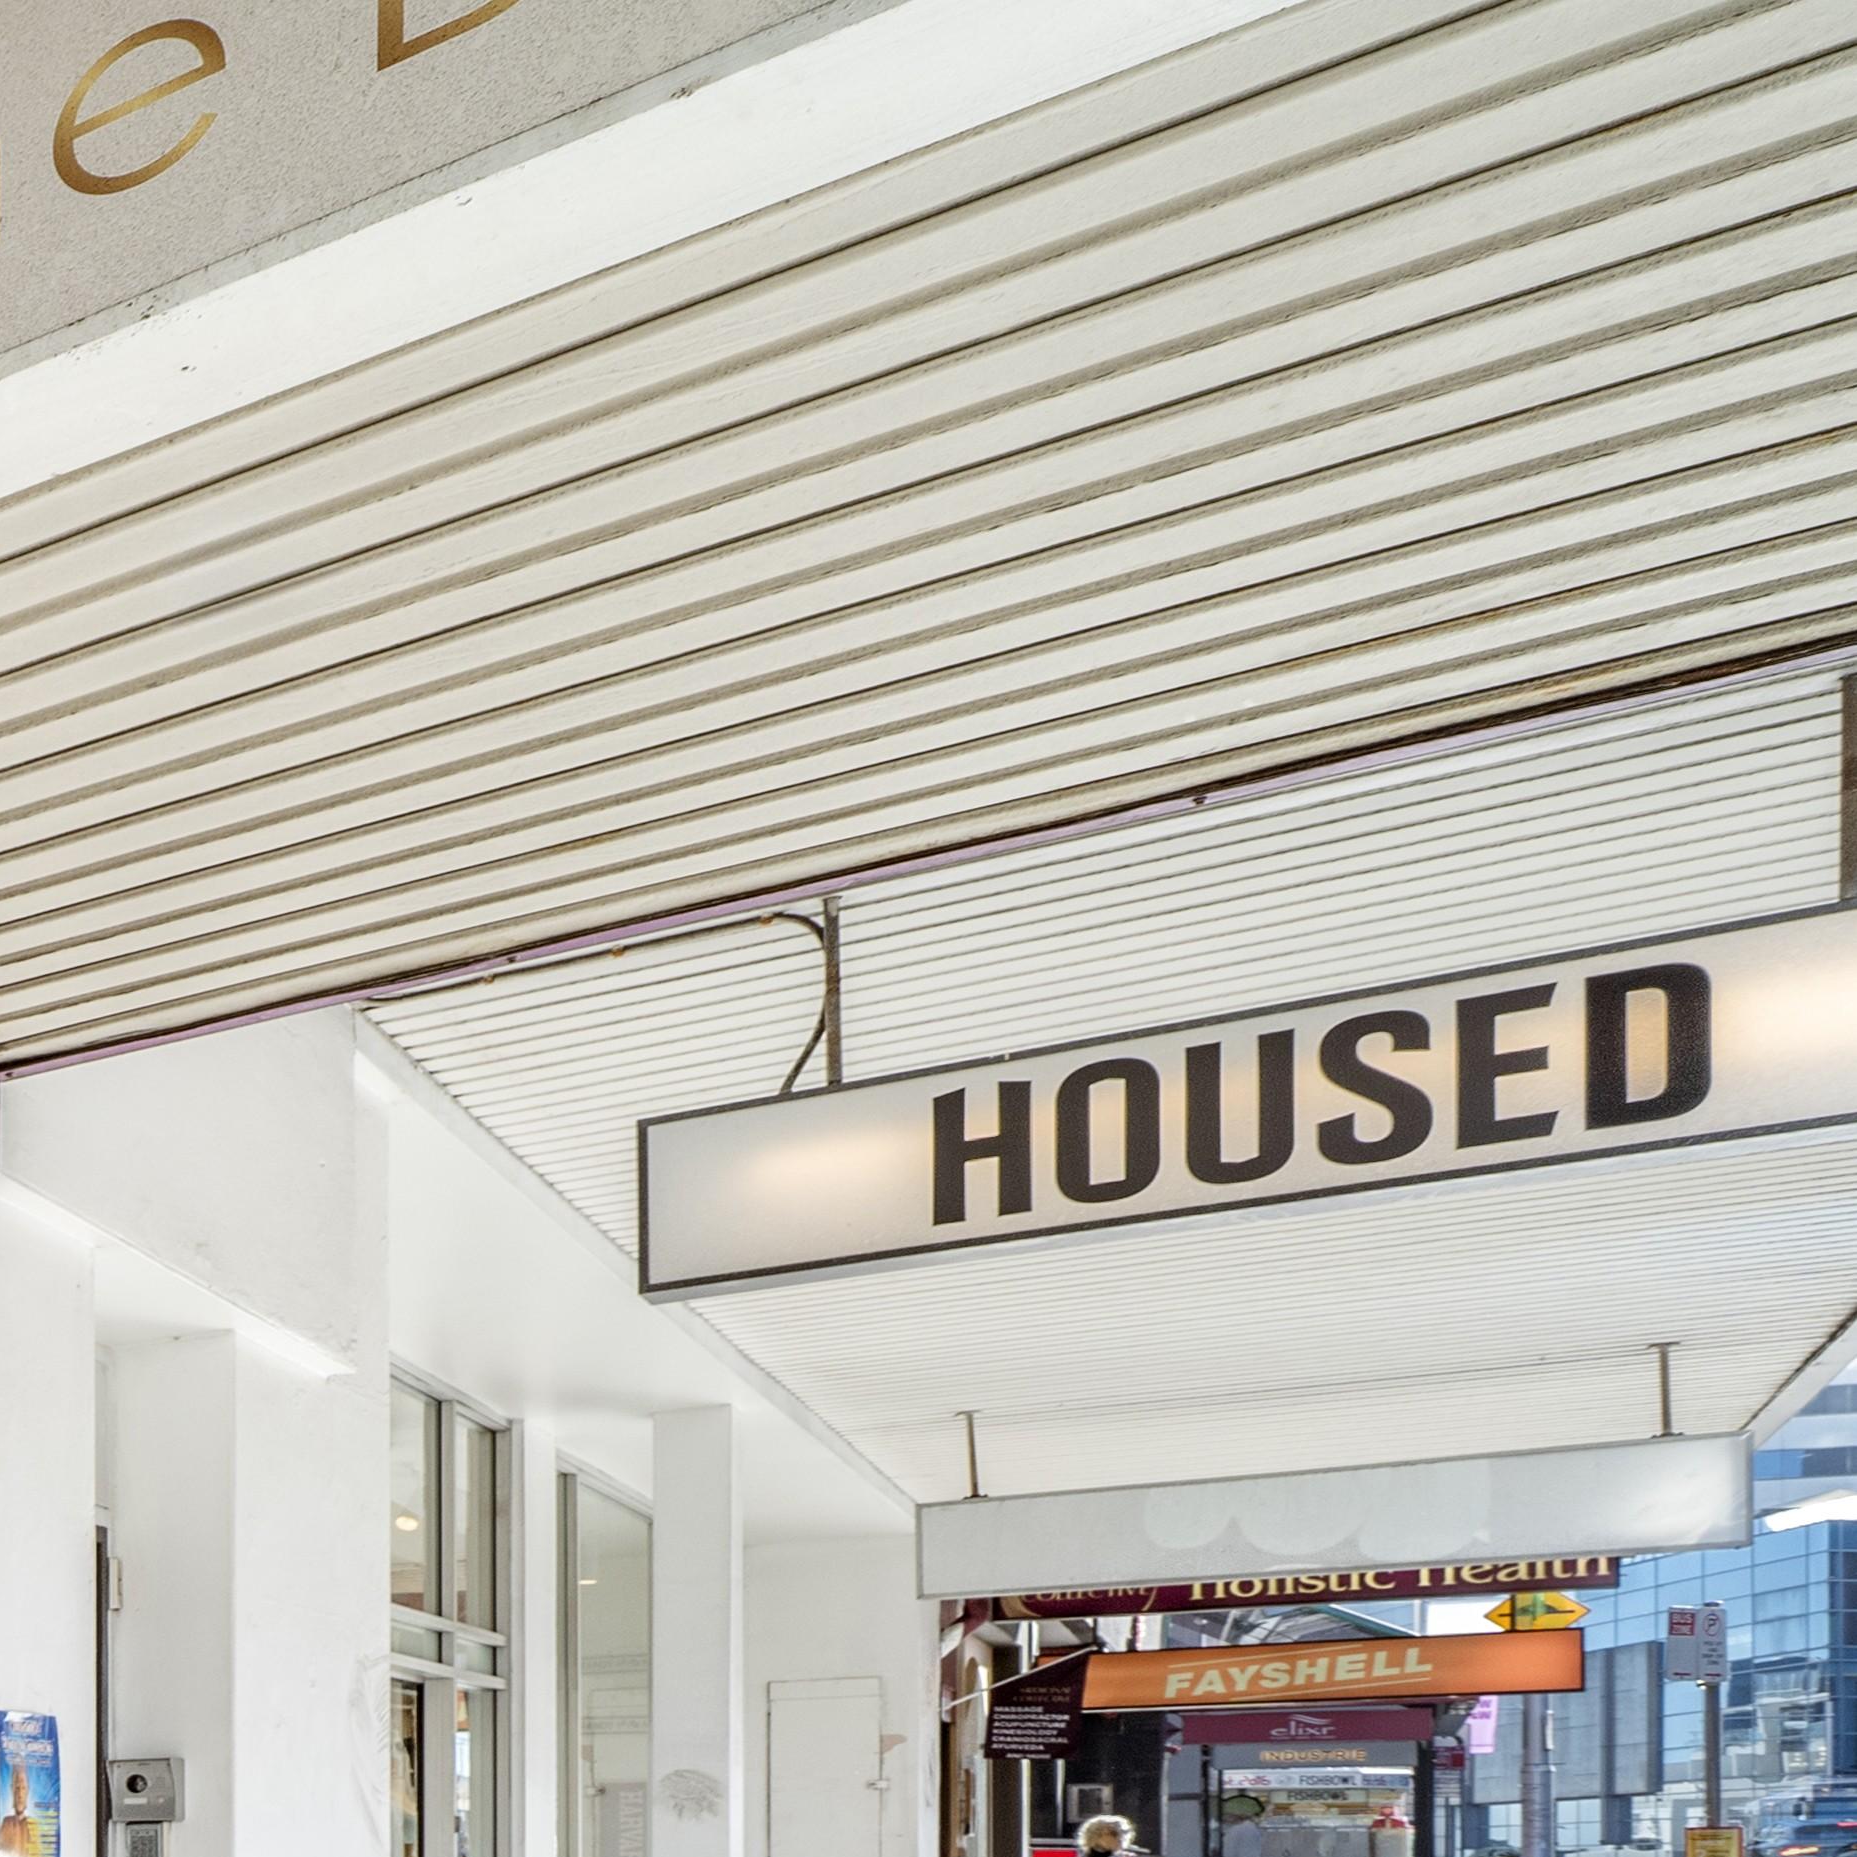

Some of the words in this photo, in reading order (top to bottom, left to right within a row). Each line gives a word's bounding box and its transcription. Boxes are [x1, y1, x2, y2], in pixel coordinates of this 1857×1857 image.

[933, 961, 1712, 1226] HOUSED
[1672, 1613, 1693, 1623] BUS
[1165, 1648, 1432, 1698] FAYSHELL
[992, 1728, 1058, 1736] KINESIOLOGY
